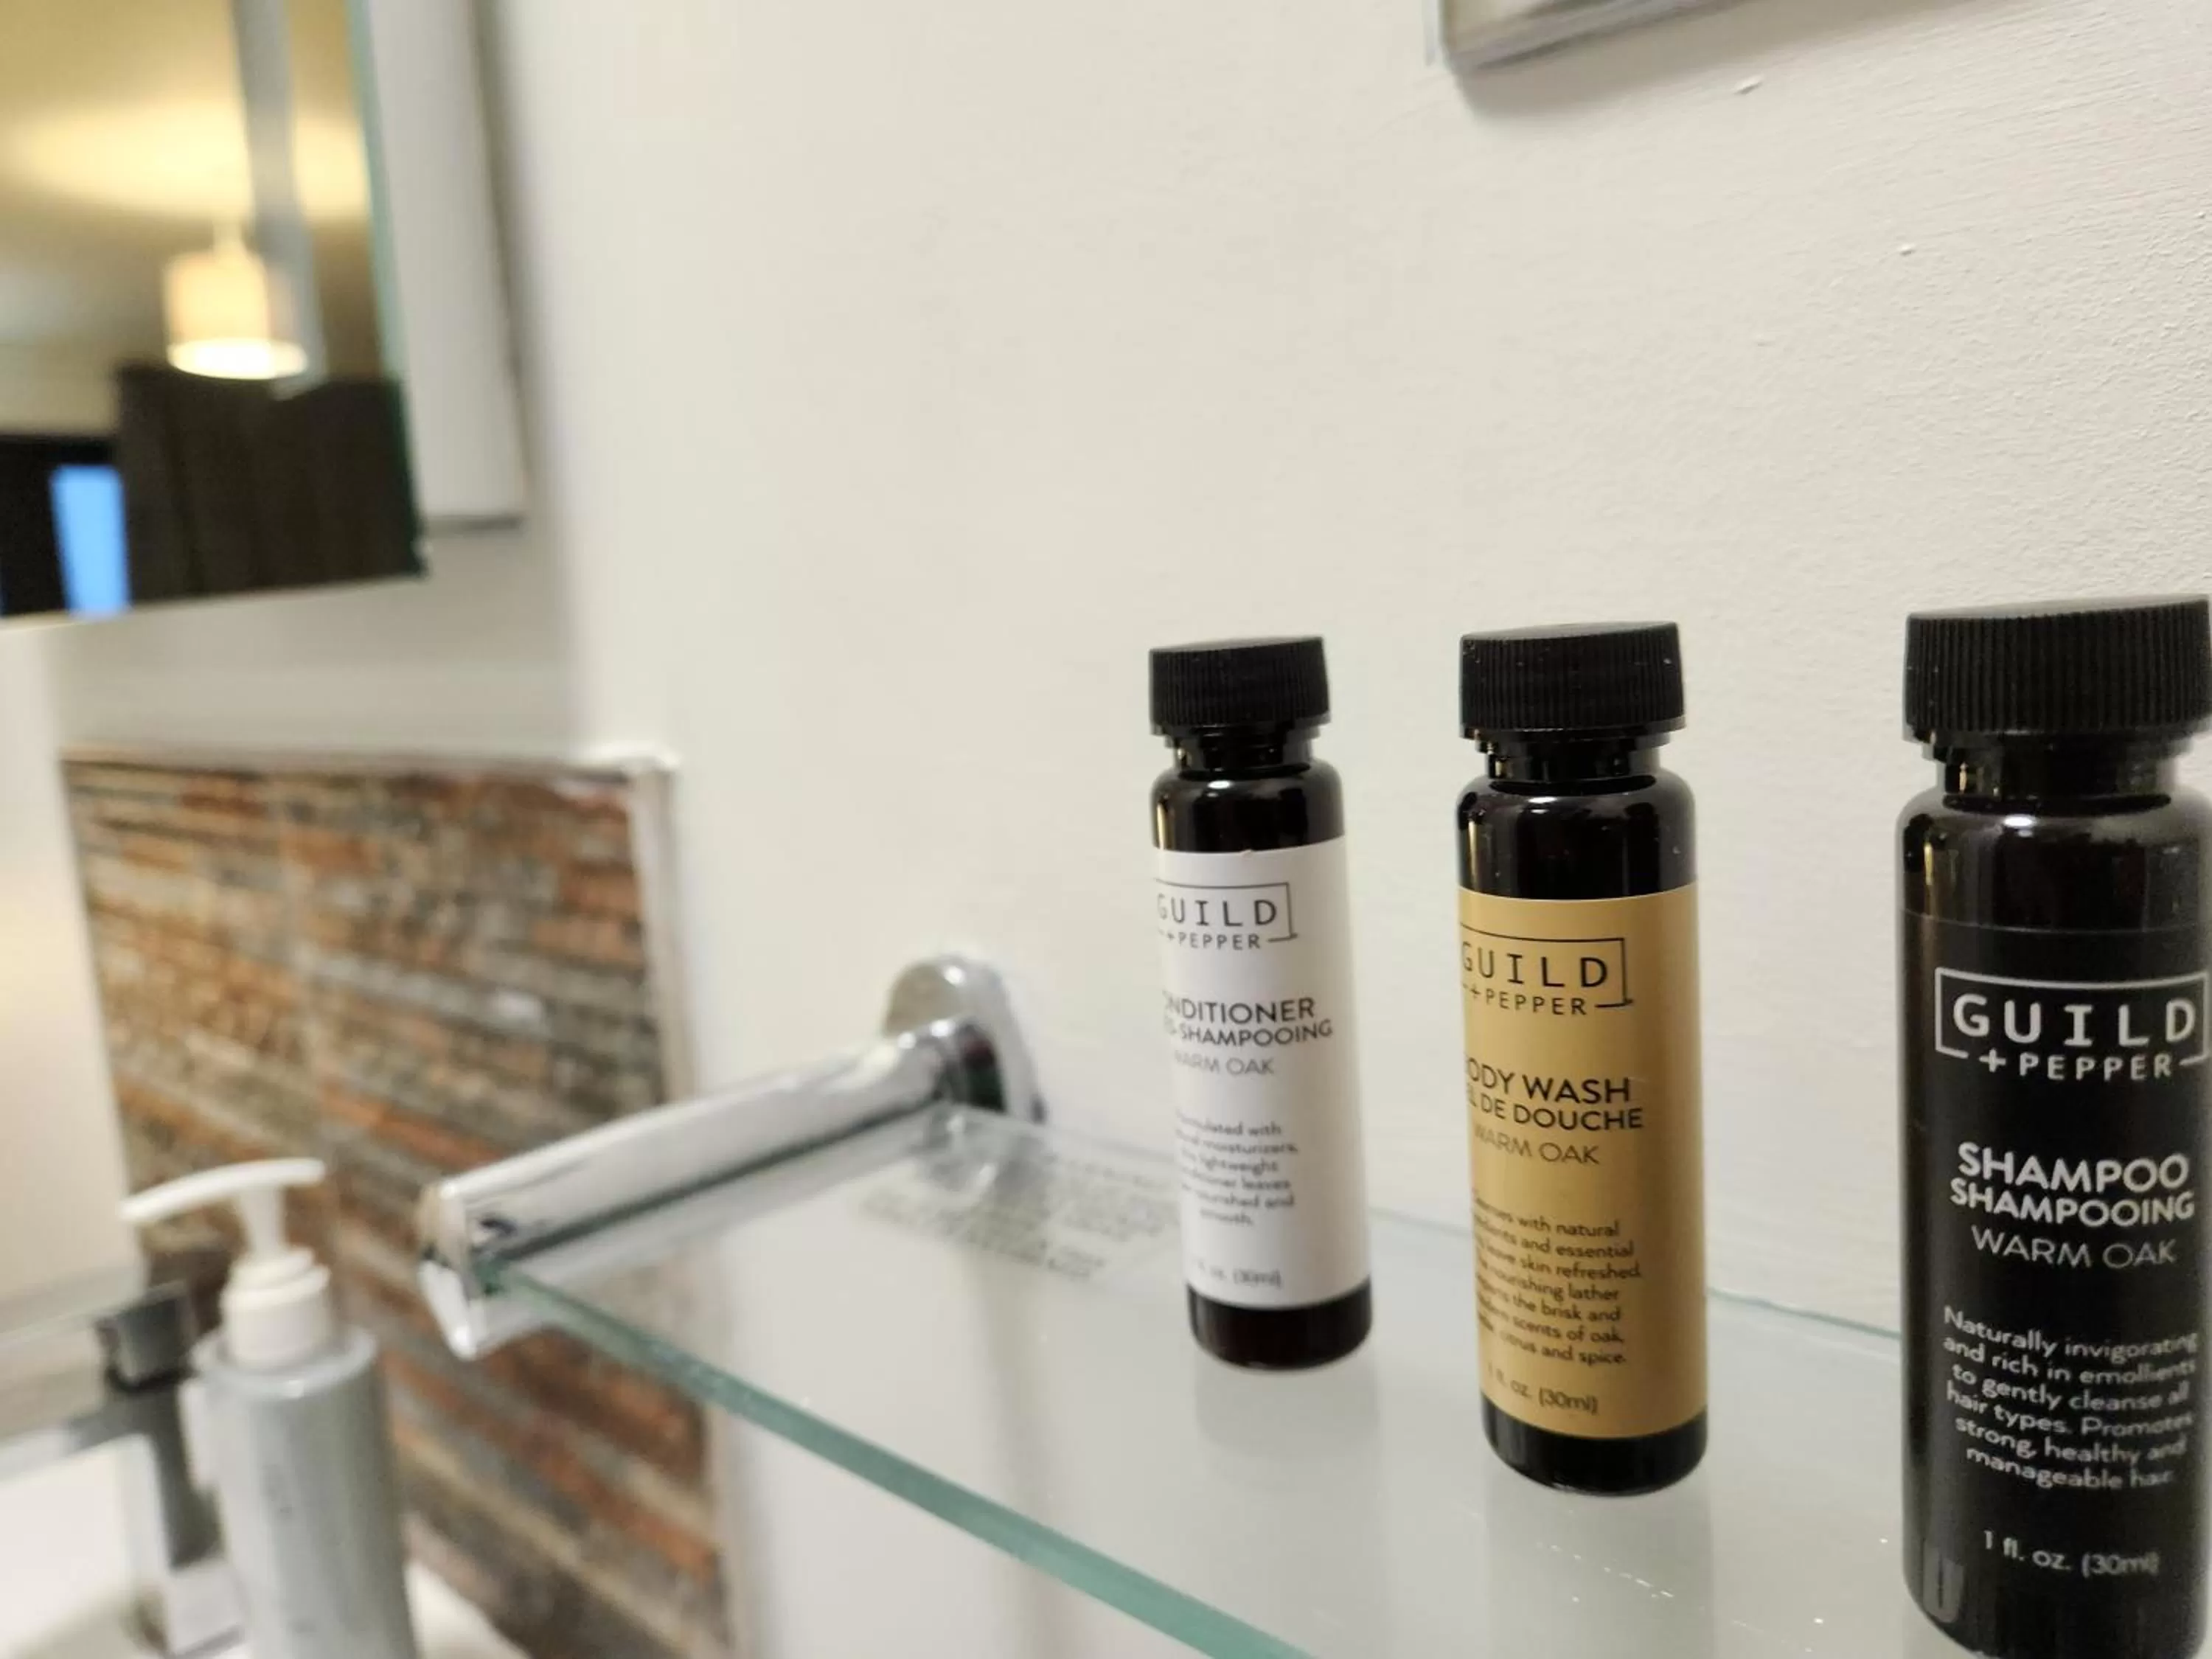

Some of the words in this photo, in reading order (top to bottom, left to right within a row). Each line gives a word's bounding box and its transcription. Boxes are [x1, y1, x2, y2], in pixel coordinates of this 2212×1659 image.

[1461, 939, 1609, 989] GUILD
[1952, 992, 2197, 1047] GUILD
[1225, 1057, 1276, 1076] OAK
[1465, 1055, 1516, 1096] ODY
[1521, 1074, 1632, 1105] WASH
[1480, 1091, 1506, 1121] DE
[1512, 1102, 1645, 1132] DOUCHE
[1474, 1122, 1533, 1159] WARM
[1538, 1142, 1601, 1166] OAK
[1957, 1141, 2191, 1194] SHAMPOO
[1265, 1192, 1295, 1209] and
[1949, 1176, 2197, 1228] SHAMPOOING
[1517, 1215, 1551, 1232] with
[1556, 1219, 1621, 1237] natural
[1520, 1237, 1551, 1253] and
[1555, 1239, 1635, 1258] essential
[1970, 1224, 2093, 1269] WARM
[2101, 1238, 2178, 1270] OAK
[1520, 1253, 1552, 1274] skin
[1512, 1291, 1537, 1313] the
[1540, 1297, 1583, 1322] brisk
[1587, 1305, 1621, 1322] and
[1568, 1281, 1620, 1301] lather
[1512, 1315, 1562, 1340] scents
[1565, 1324, 1586, 1342] of
[1943, 1304, 2059, 1359] Naturally
[1540, 1344, 1574, 1362] and
[1941, 1336, 1986, 1365] and
[1991, 1352, 2039, 1379] rich
[2046, 1360, 2072, 1383] in
[1946, 1379, 1989, 1414] hair
[1993, 1404, 2073, 1433] types.
[1951, 1363, 1978, 1385] to
[1981, 1377, 2062, 1411] gently
[2067, 1388, 2163, 1411] cleanse
[1955, 1416, 2038, 1459] strong,
[2043, 1435, 2141, 1467] healthy
[2146, 1433, 2188, 1461] and
[1965, 1447, 2124, 1489] manageable
[1983, 1528, 1994, 1551] 1
[2002, 1536, 2026, 1562] fl.
[2031, 1549, 2072, 1572] oz.
